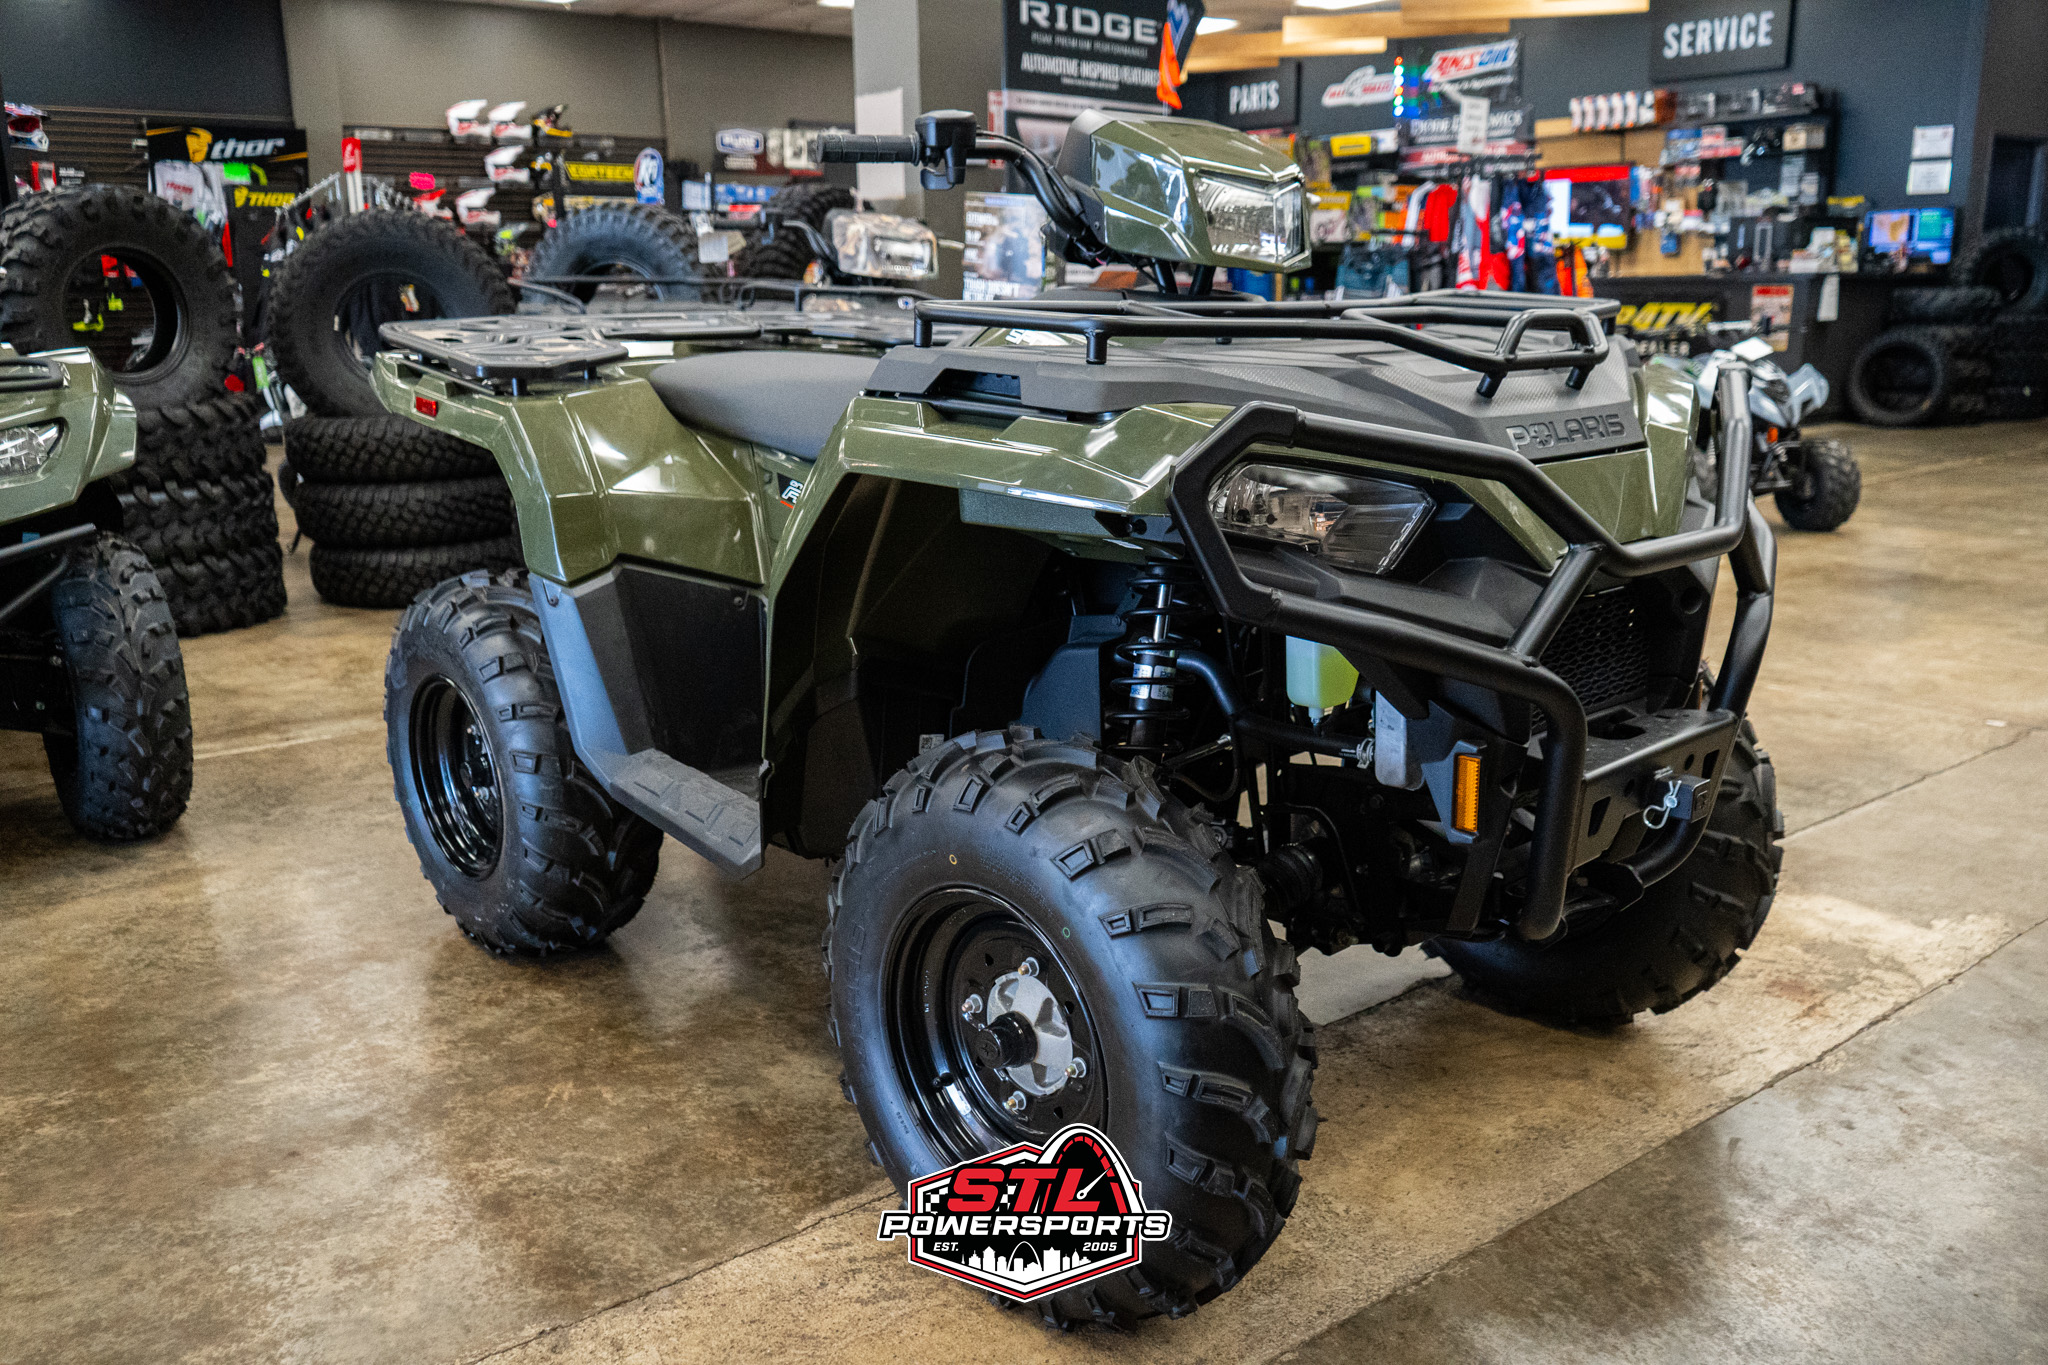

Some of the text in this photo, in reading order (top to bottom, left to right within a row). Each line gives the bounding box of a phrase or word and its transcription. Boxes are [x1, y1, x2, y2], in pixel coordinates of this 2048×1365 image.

[1019, 0, 1158, 45] RIDGE
[1663, 10, 1775, 59] SERVICE
[1021, 52, 1079, 76] AUTOMOTIVE
[1229, 79, 1280, 115] PARTS
[210, 138, 286, 159] thor
[249, 191, 296, 207] THOR
[1506, 413, 1627, 452] POLARIS
